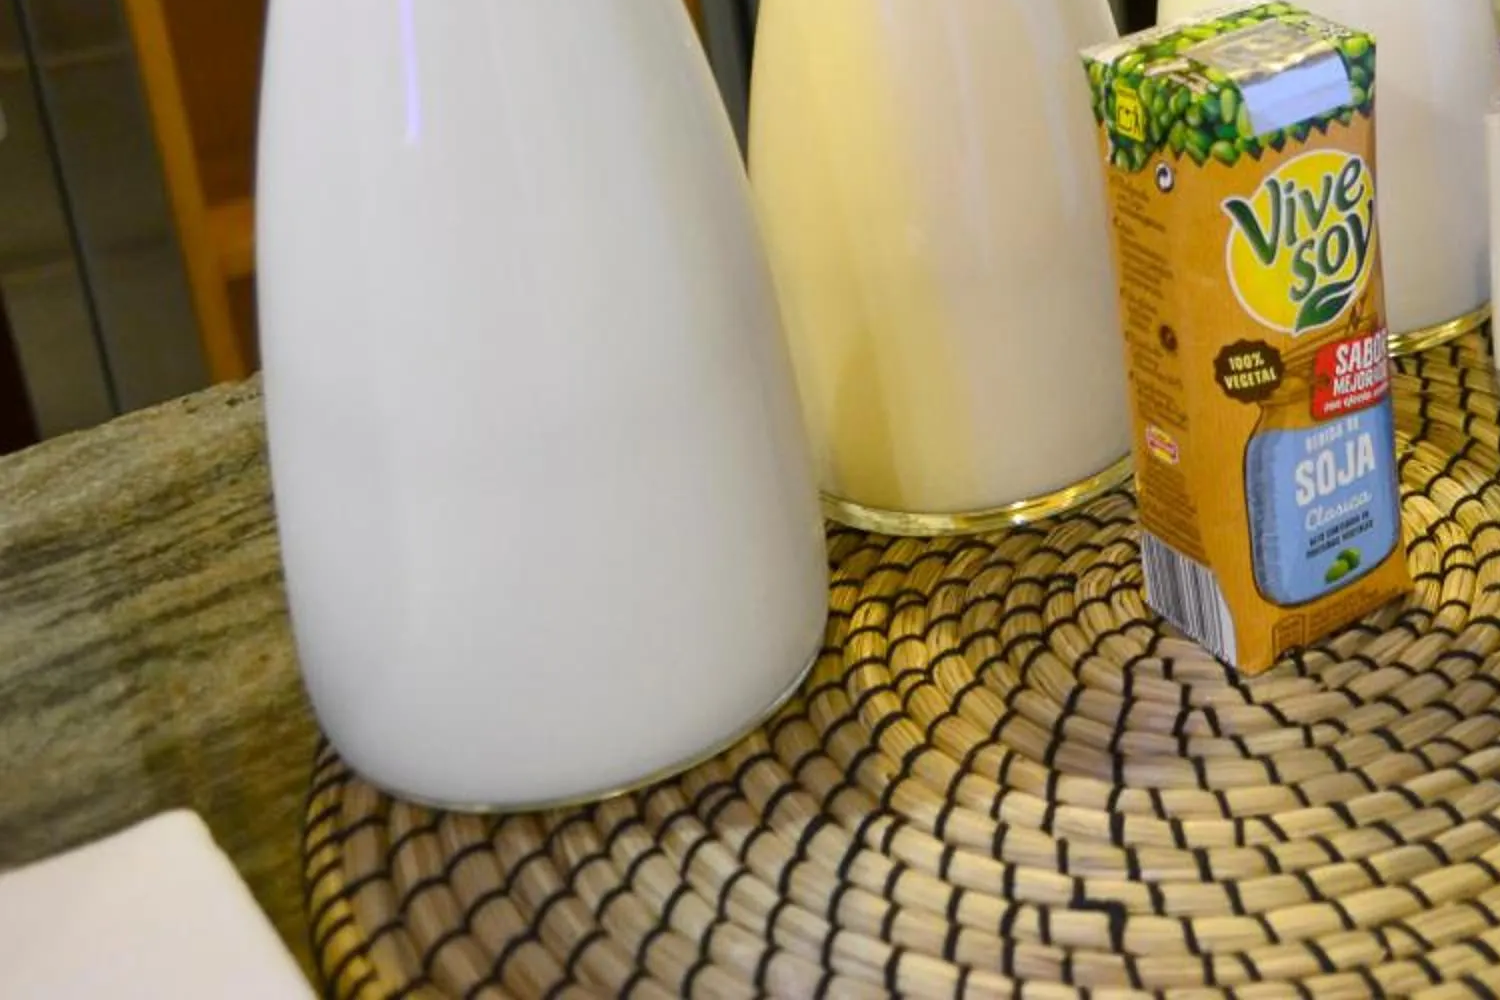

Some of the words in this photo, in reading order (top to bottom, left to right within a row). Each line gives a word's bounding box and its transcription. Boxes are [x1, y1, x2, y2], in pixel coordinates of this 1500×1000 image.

[1225, 157, 1365, 266] Vive
[1288, 199, 1375, 302] soy
[1223, 366, 1277, 390] VEGETAL
[1228, 351, 1266, 371] 100%
[1295, 431, 1376, 508] SOJA
